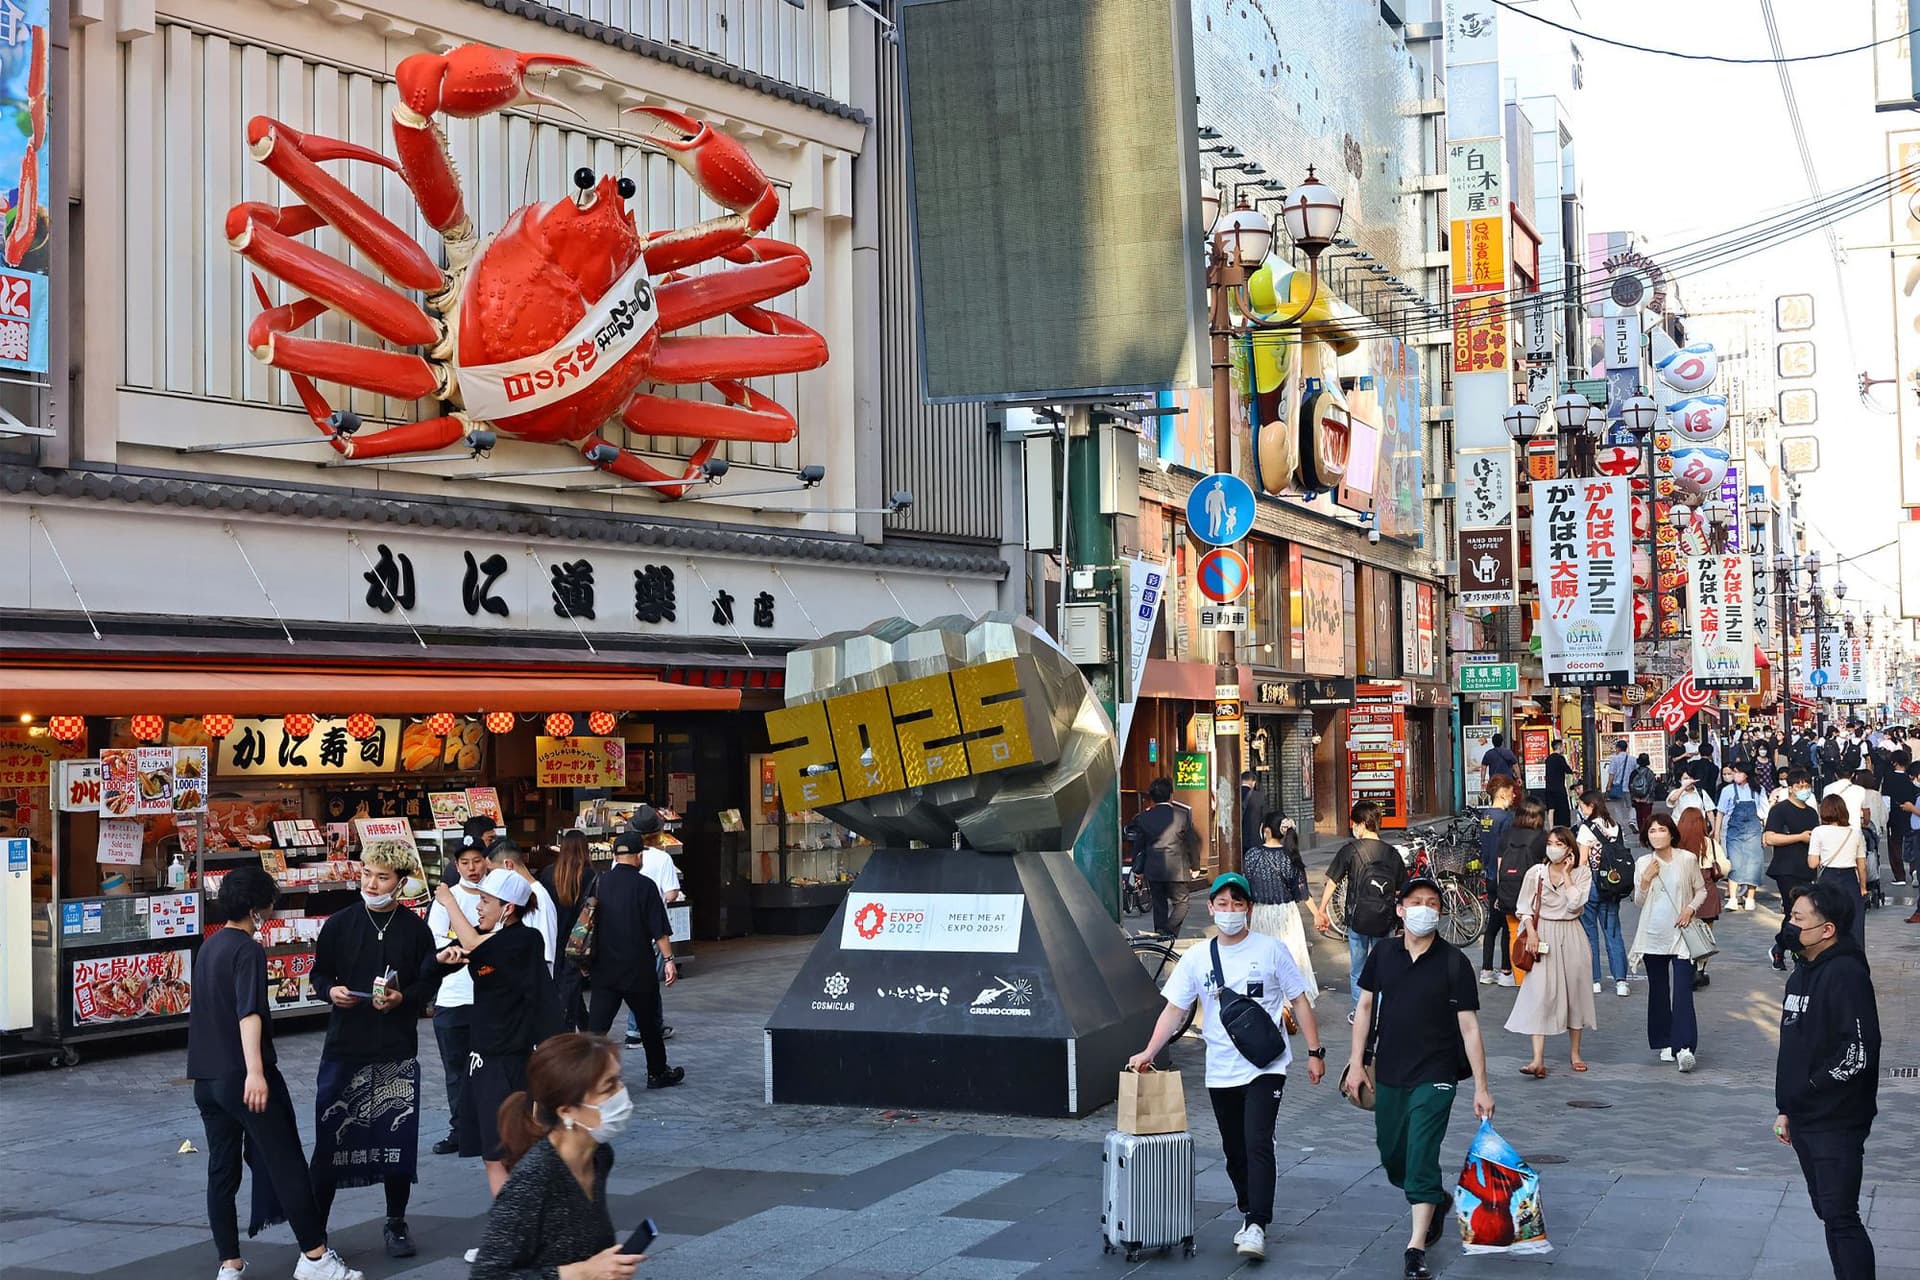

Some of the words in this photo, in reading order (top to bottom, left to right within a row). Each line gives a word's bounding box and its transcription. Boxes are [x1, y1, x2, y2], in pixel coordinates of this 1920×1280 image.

[1450, 146, 1464, 158] 4F
[1466, 149, 1499, 212] 白木屋
[1474, 222, 1491, 281] 鳥貴族
[1471, 284, 1486, 293] 3F
[1473, 458, 1498, 521] ぼてぢゅう
[1472, 542, 1499, 550] COFFEE
[1584, 482, 1617, 615] がんばれミナミ
[1500, 578, 1511, 587] 1F
[1722, 556, 1743, 643] がんばれミナミ
[1201, 611, 1246, 626] 自動車
[1820, 634, 1832, 668] がんばれ
[1566, 660, 1605, 670] docomo
[764, 657, 1035, 813] 2025
[232, 725, 387, 769] かに寿司
[889, 912, 925, 923] EXPO
[948, 913, 975, 922] MEET
[977, 914, 992, 922] ME
[994, 914, 1006, 922] AT
[888, 923, 923, 934] 2025
[947, 924, 975, 933] EXPO
[75, 954, 164, 983] かに炭火焼
[810, 1000, 855, 1012] COSMICLAB
